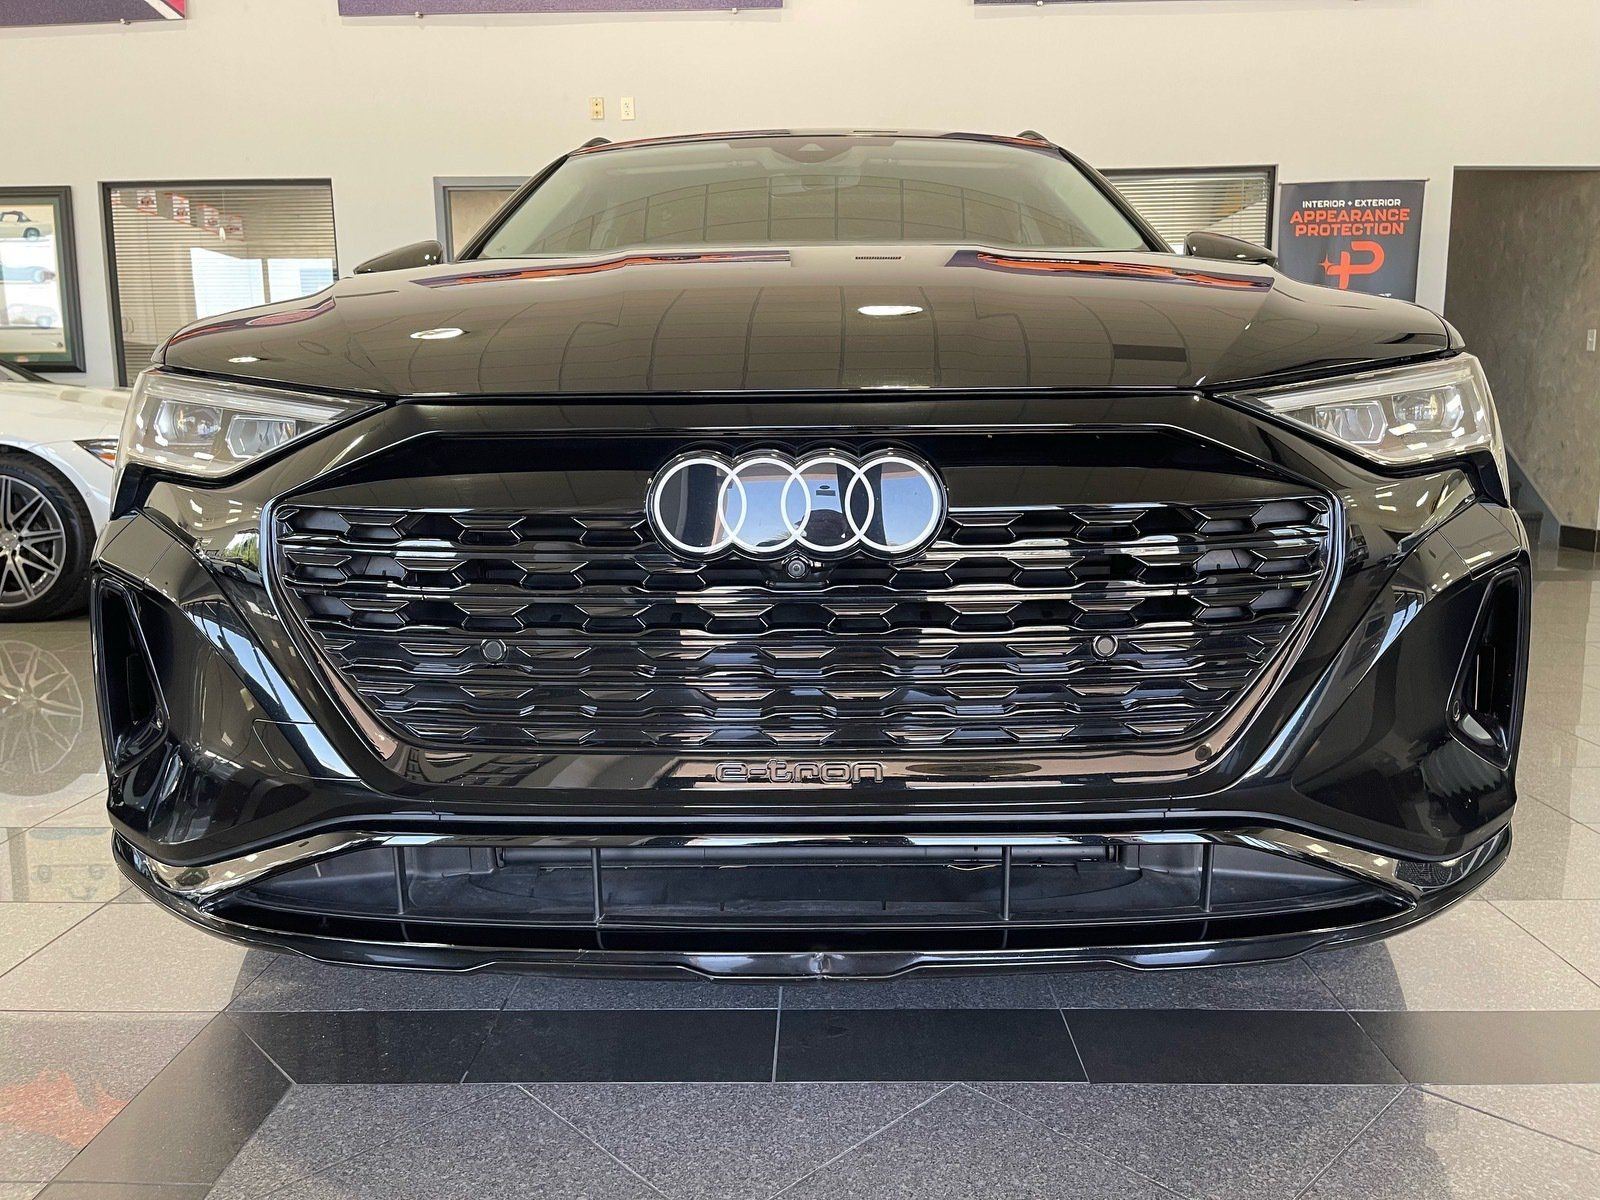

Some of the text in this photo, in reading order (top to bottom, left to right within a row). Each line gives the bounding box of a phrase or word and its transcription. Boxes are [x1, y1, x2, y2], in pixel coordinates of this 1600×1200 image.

[1302, 199, 1345, 208] INTERIOR
[1354, 198, 1401, 207] EXTERIOR
[1290, 208, 1410, 224] APPEARANCE
[1295, 222, 1404, 237] PROTECTION
[715, 758, 884, 784] e-tron
